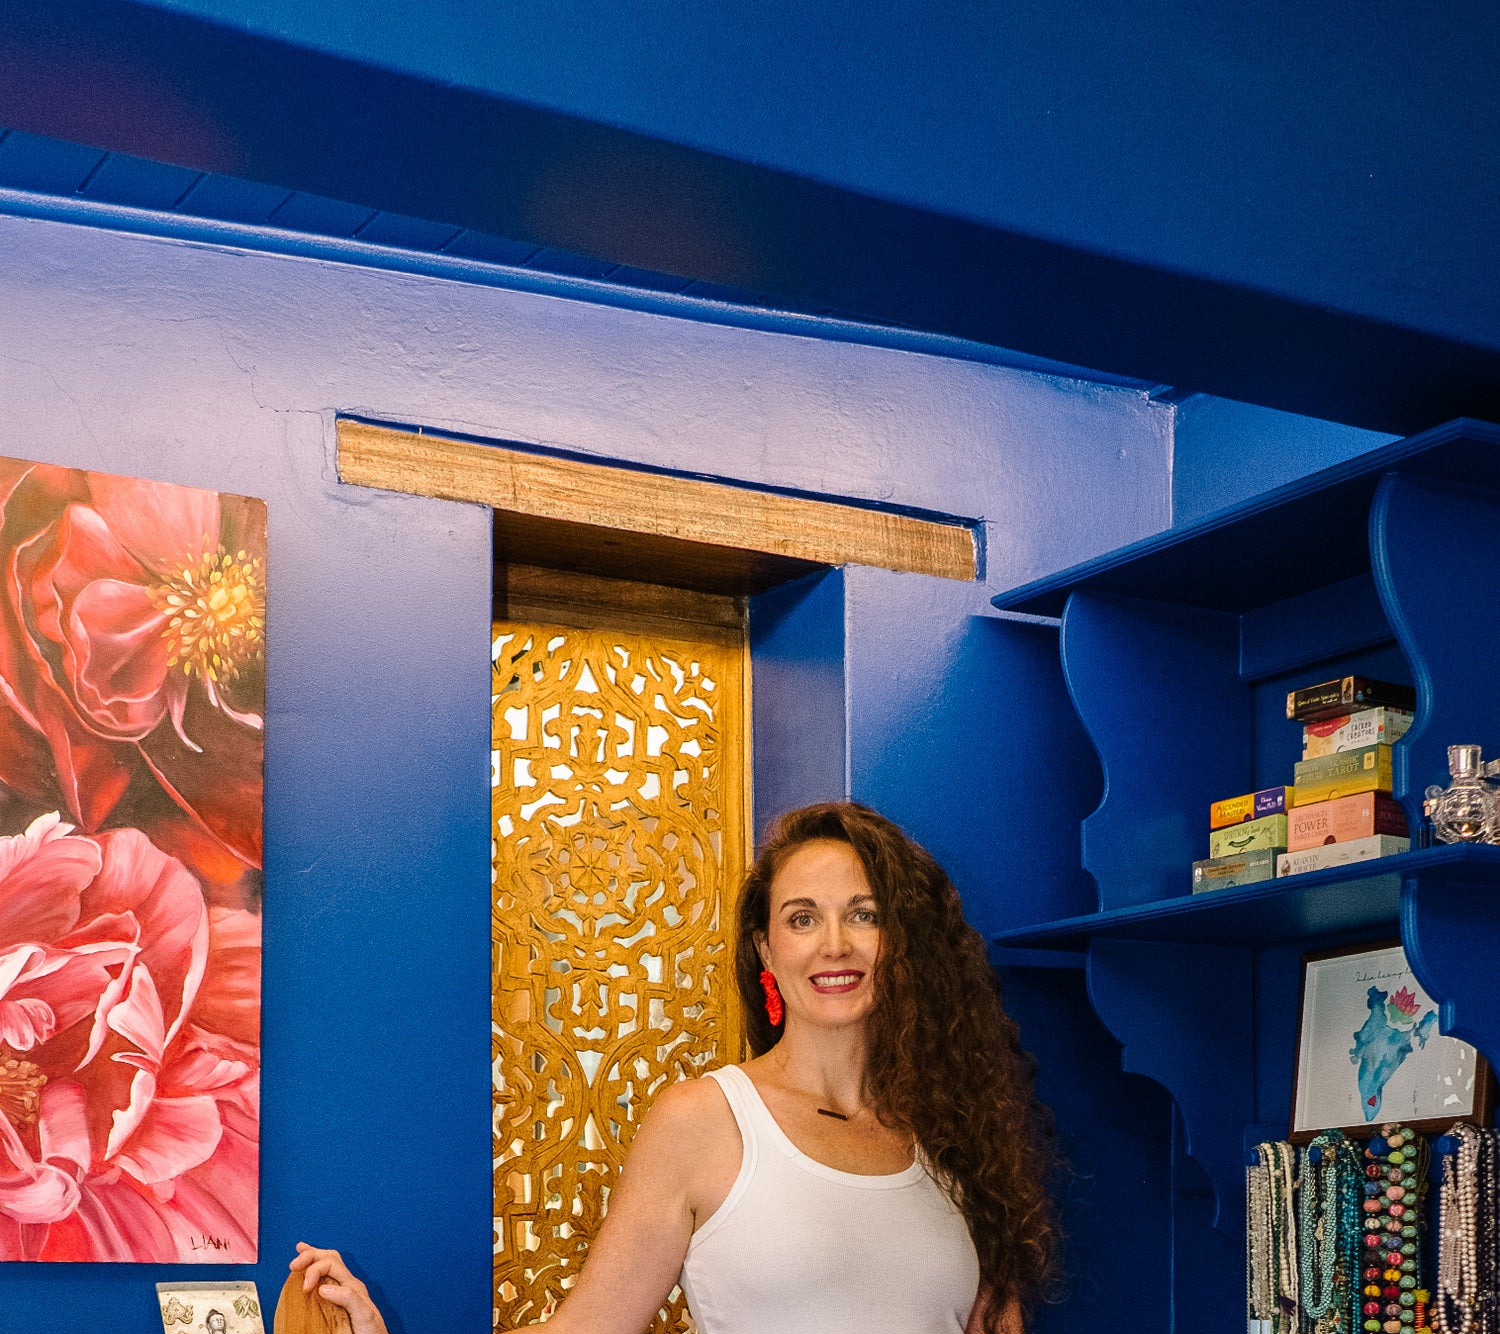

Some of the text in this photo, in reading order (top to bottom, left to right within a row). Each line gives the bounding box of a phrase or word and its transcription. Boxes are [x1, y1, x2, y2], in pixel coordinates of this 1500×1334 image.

[1328, 763, 1360, 776] TAROT
[1216, 800, 1249, 812] ASCENDED
[1219, 808, 1245, 819] MASTERS
[1294, 818, 1329, 834] POWER
